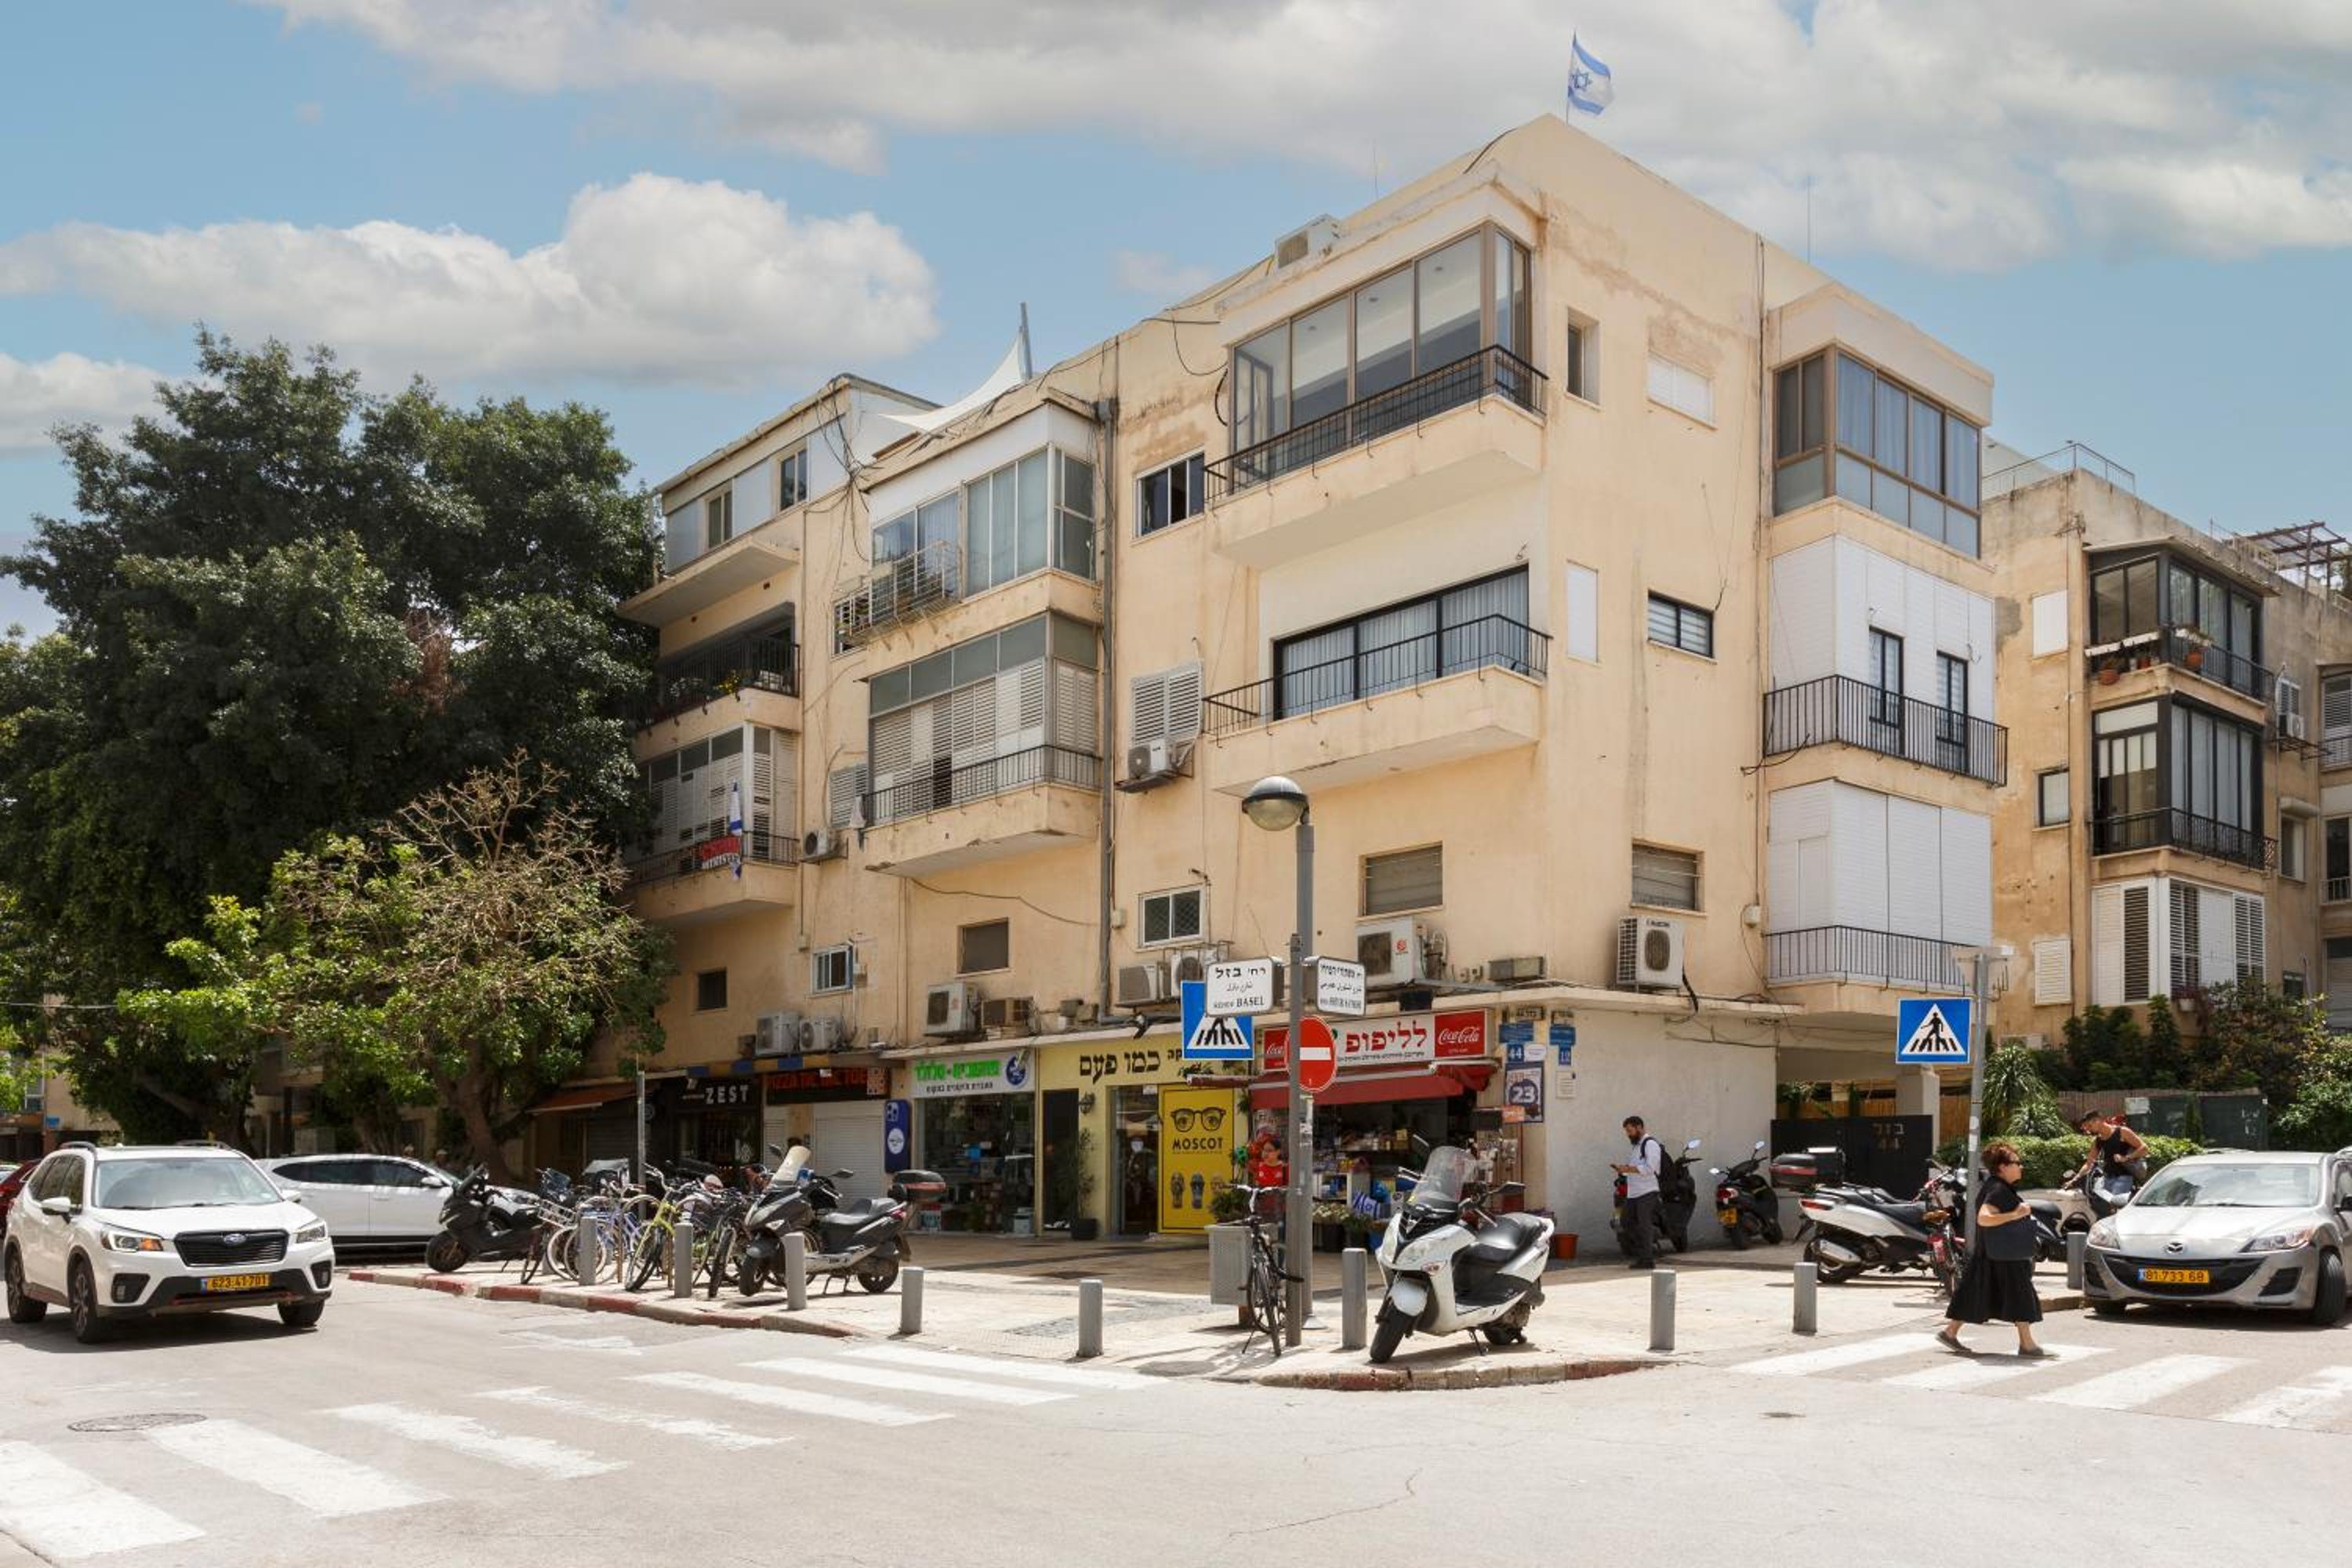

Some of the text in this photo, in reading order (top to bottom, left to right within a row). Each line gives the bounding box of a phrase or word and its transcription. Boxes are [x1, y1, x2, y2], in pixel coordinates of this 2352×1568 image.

[1214, 967, 1242, 979] בזל
[1236, 995, 1265, 1007] BASEL
[1080, 1050, 1160, 1085] כמו פעם
[705, 1084, 750, 1105] ZEST
[1512, 1087, 1536, 1104] 23
[1172, 1138, 1223, 1150] MOSCOT
